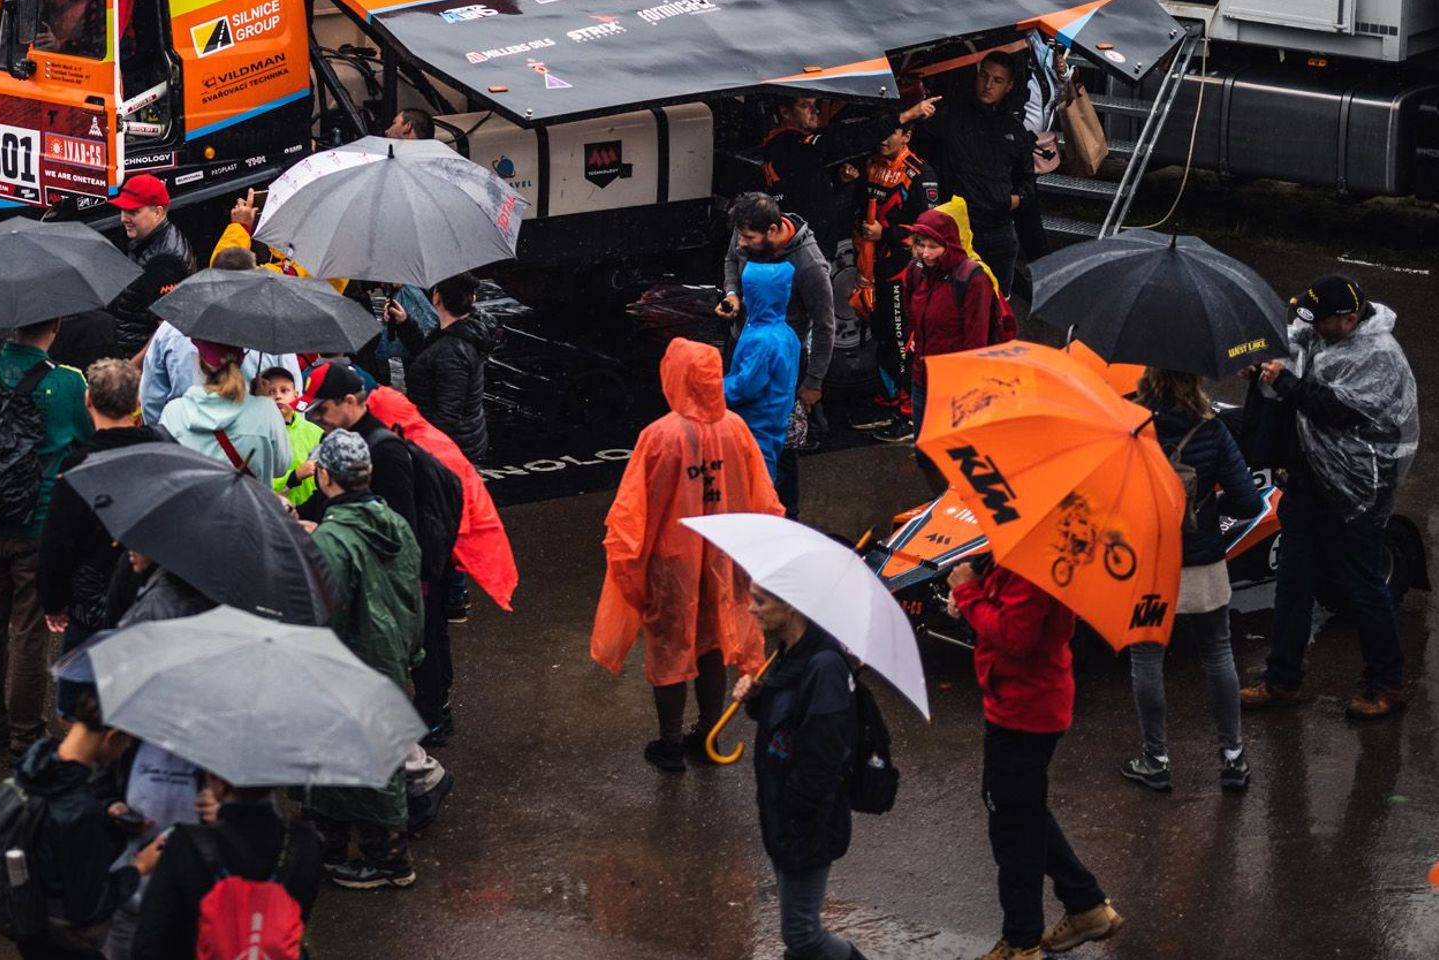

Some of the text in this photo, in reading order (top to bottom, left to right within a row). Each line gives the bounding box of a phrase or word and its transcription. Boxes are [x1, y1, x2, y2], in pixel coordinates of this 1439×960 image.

[232, 0, 281, 26] SILNICE
[235, 16, 281, 42] GROUP
[567, 21, 623, 41] STRIX
[483, 38, 556, 60] MILLERS OILS
[216, 53, 287, 85] VILDMAN
[249, 68, 289, 87] TECHNIKA
[124, 153, 171, 166] CHNOLOGY
[44, 169, 106, 187] WE ARE ONETEAM
[893, 285, 903, 338] ONETEAM
[946, 445, 1021, 525] KTM
[1129, 594, 1168, 630] KTM
